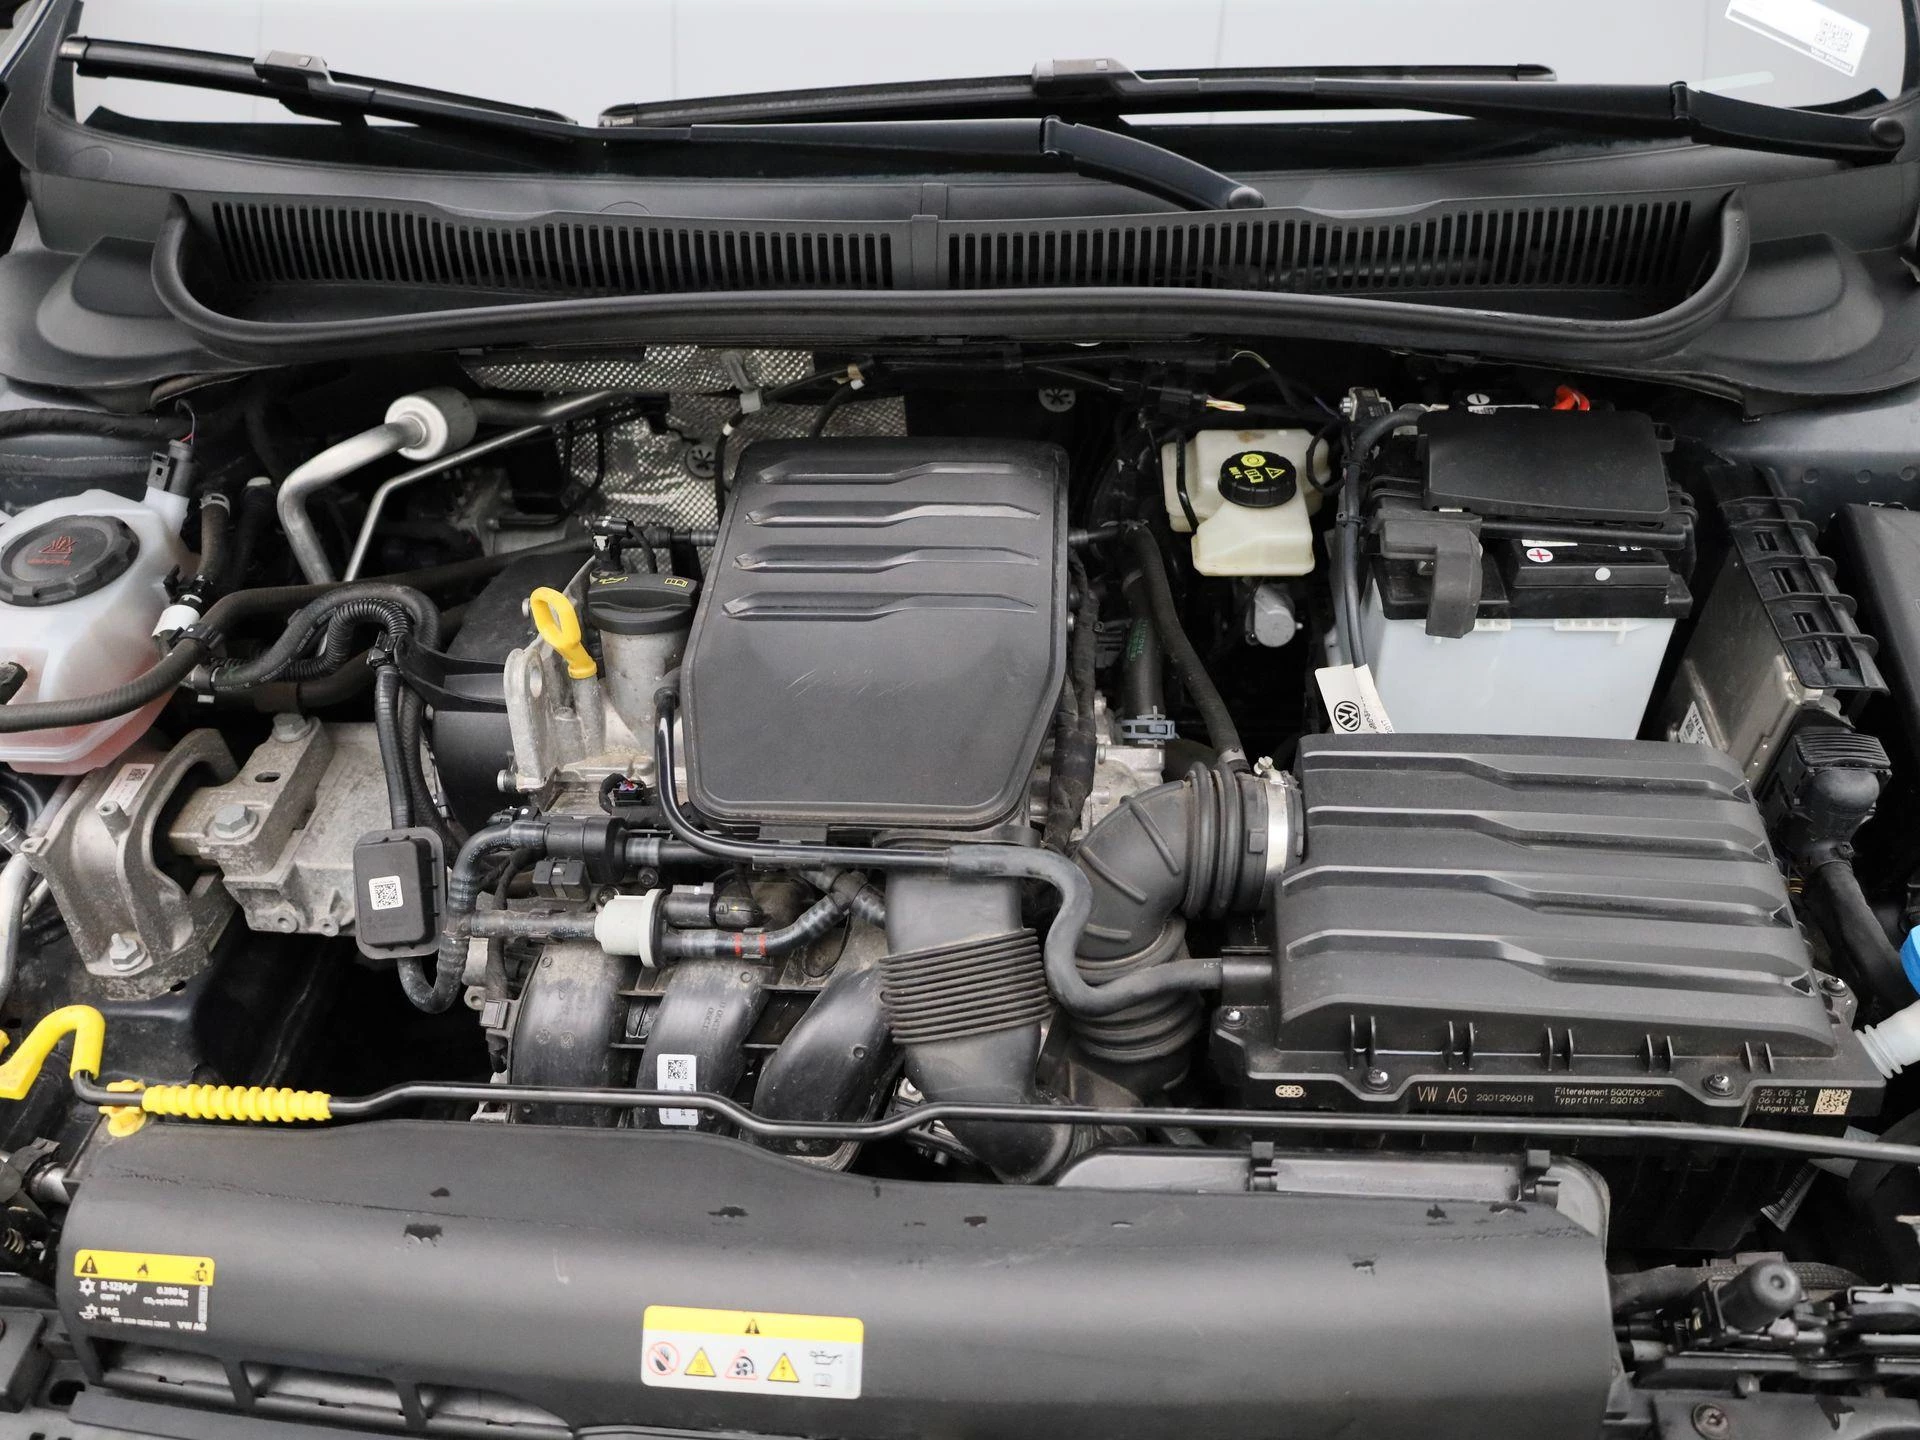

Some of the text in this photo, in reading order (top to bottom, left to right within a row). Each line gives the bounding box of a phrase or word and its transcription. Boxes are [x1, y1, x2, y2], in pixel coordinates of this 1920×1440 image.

[1417, 1086, 1438, 1103] VW
[1446, 1087, 1468, 1104] AG
[1554, 1087, 1608, 1097] Filterelement
[1756, 1105, 1788, 1114] Hungary
